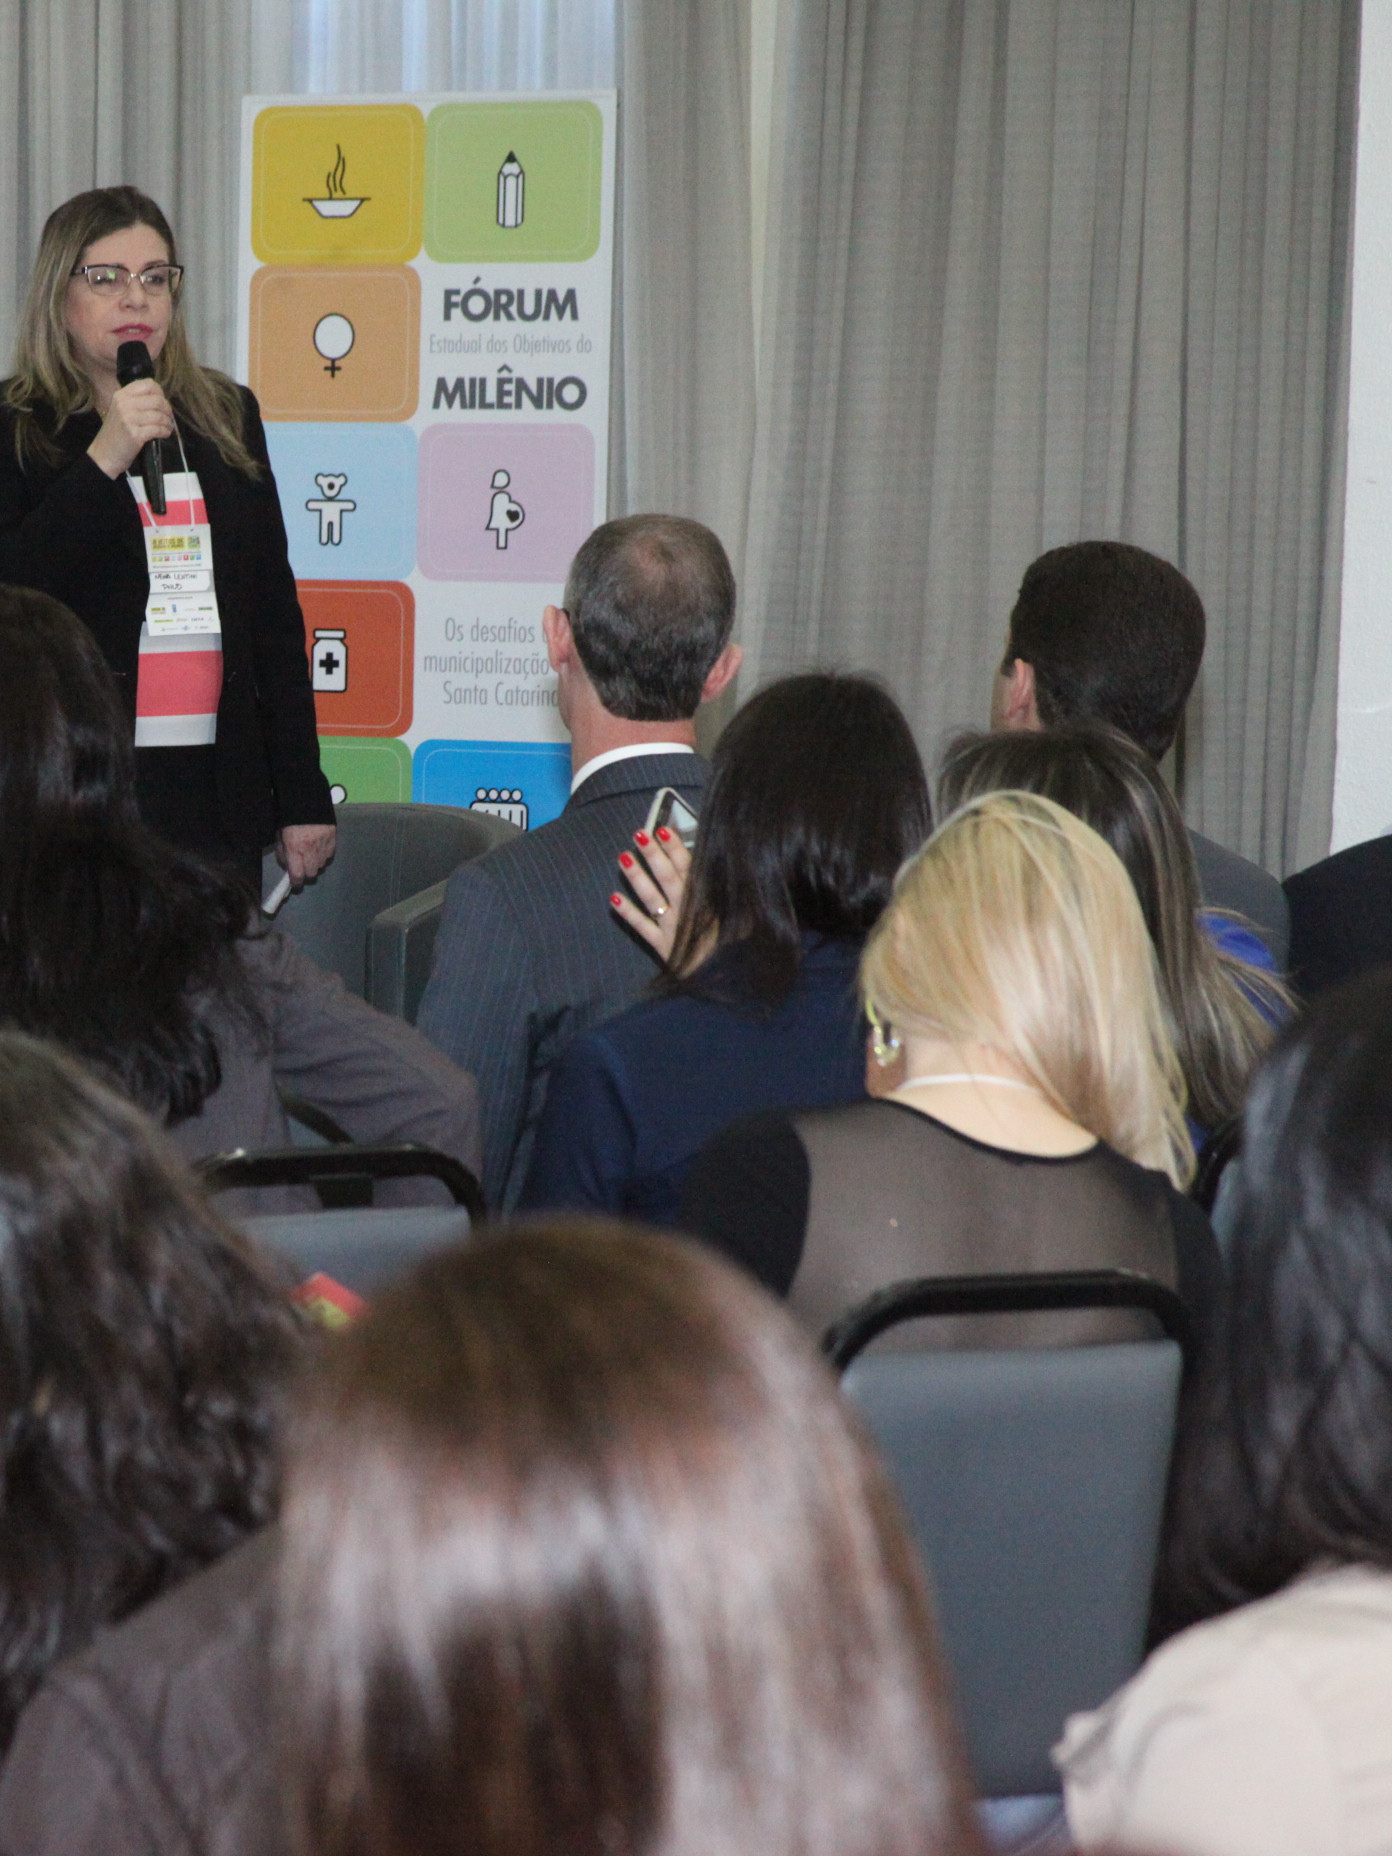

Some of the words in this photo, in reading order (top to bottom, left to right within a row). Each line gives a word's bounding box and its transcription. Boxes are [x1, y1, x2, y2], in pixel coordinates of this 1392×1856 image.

[443, 276, 579, 322] FÓRUM
[429, 333, 482, 354] Estadual
[486, 334, 508, 354] dos
[513, 334, 571, 357] Objetivos
[576, 334, 592, 354] do
[432, 363, 588, 411] MILÊNIO
[444, 617, 464, 642] Os
[470, 617, 535, 643] desafios
[423, 650, 550, 680] municipalização
[443, 680, 488, 705] Santa
